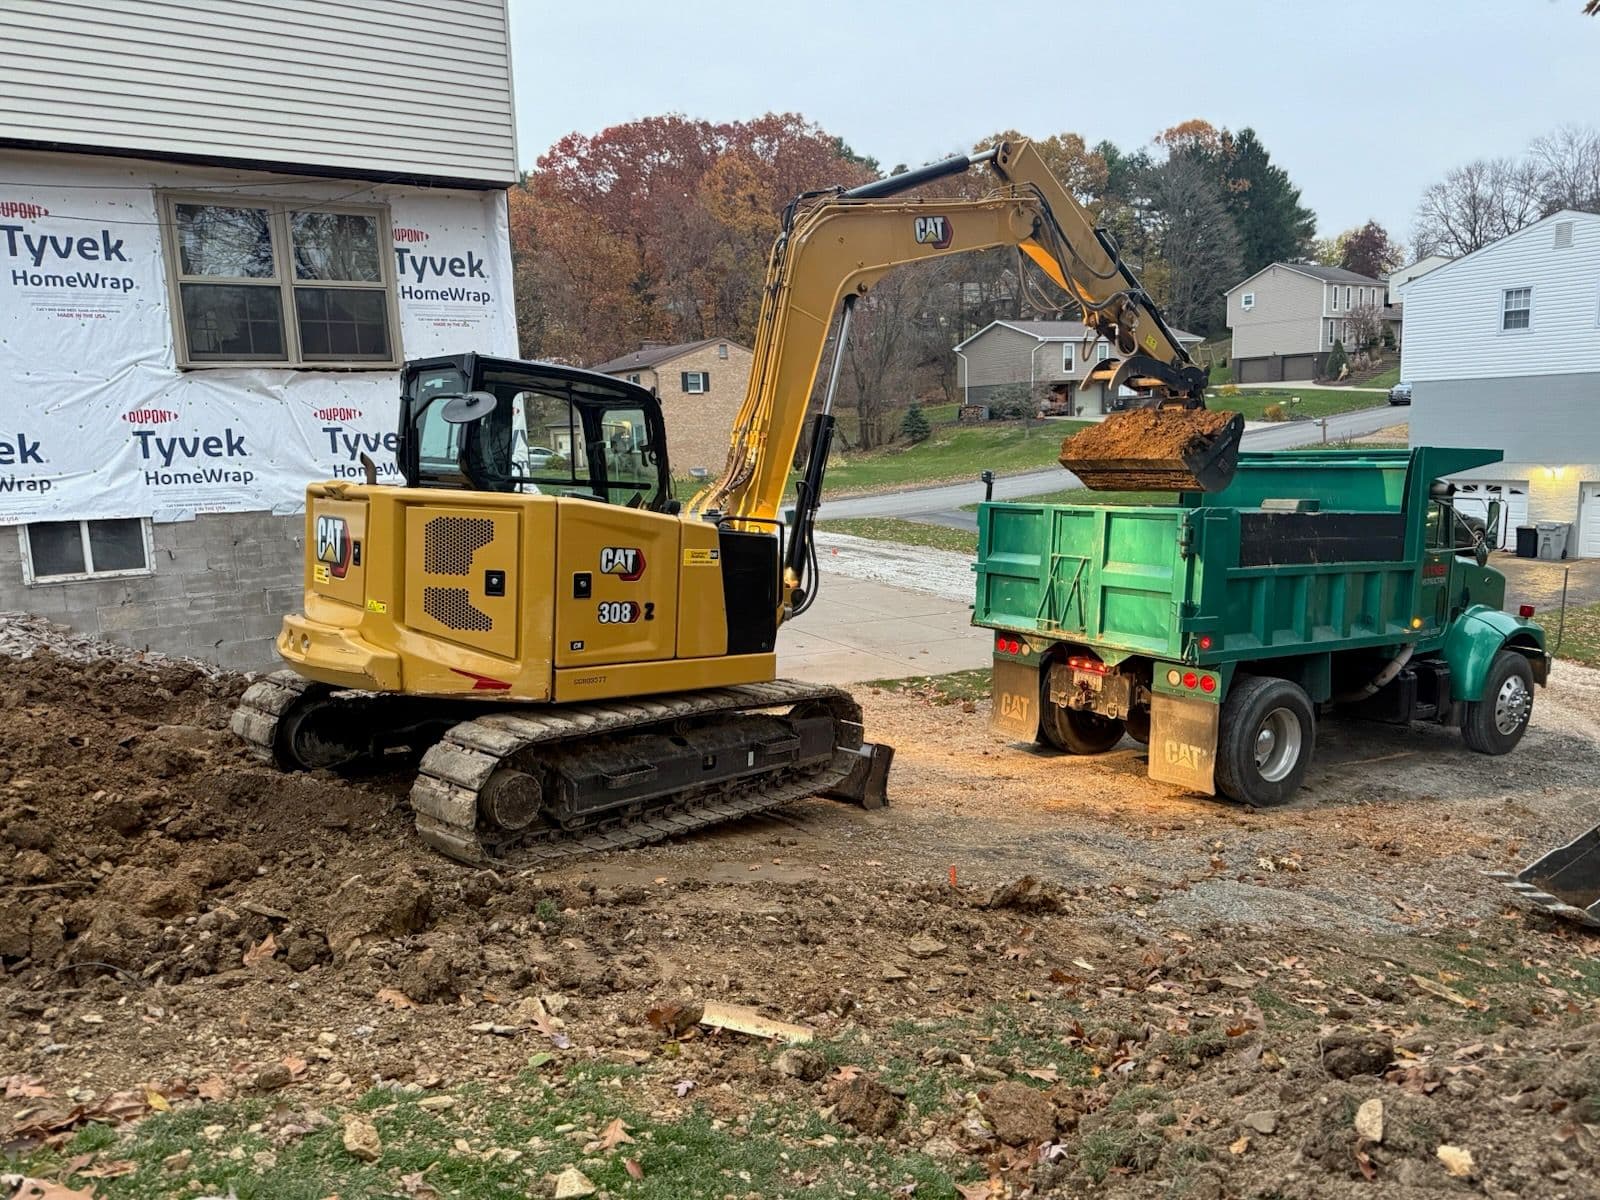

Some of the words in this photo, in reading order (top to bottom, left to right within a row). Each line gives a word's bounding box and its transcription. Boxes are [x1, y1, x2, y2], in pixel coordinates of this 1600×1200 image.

[393, 228, 425, 243] UPONT
[915, 216, 944, 243] CAT
[0, 224, 126, 267] Tyvek
[394, 247, 485, 284] Tyvek
[12, 269, 134, 293] HomeWrap
[401, 285, 491, 306] HomeWrap
[128, 409, 173, 424] DUPONT
[319, 407, 357, 421] DUPONT
[132, 428, 248, 468] Tyvek
[322, 427, 398, 461] Tyve
[145, 468, 254, 486] HomeWrap
[317, 517, 344, 563] CAT
[601, 548, 636, 573] CAT
[599, 602, 632, 623] 308
[1001, 693, 1030, 722] CAT
[1165, 740, 1201, 771] CAT
